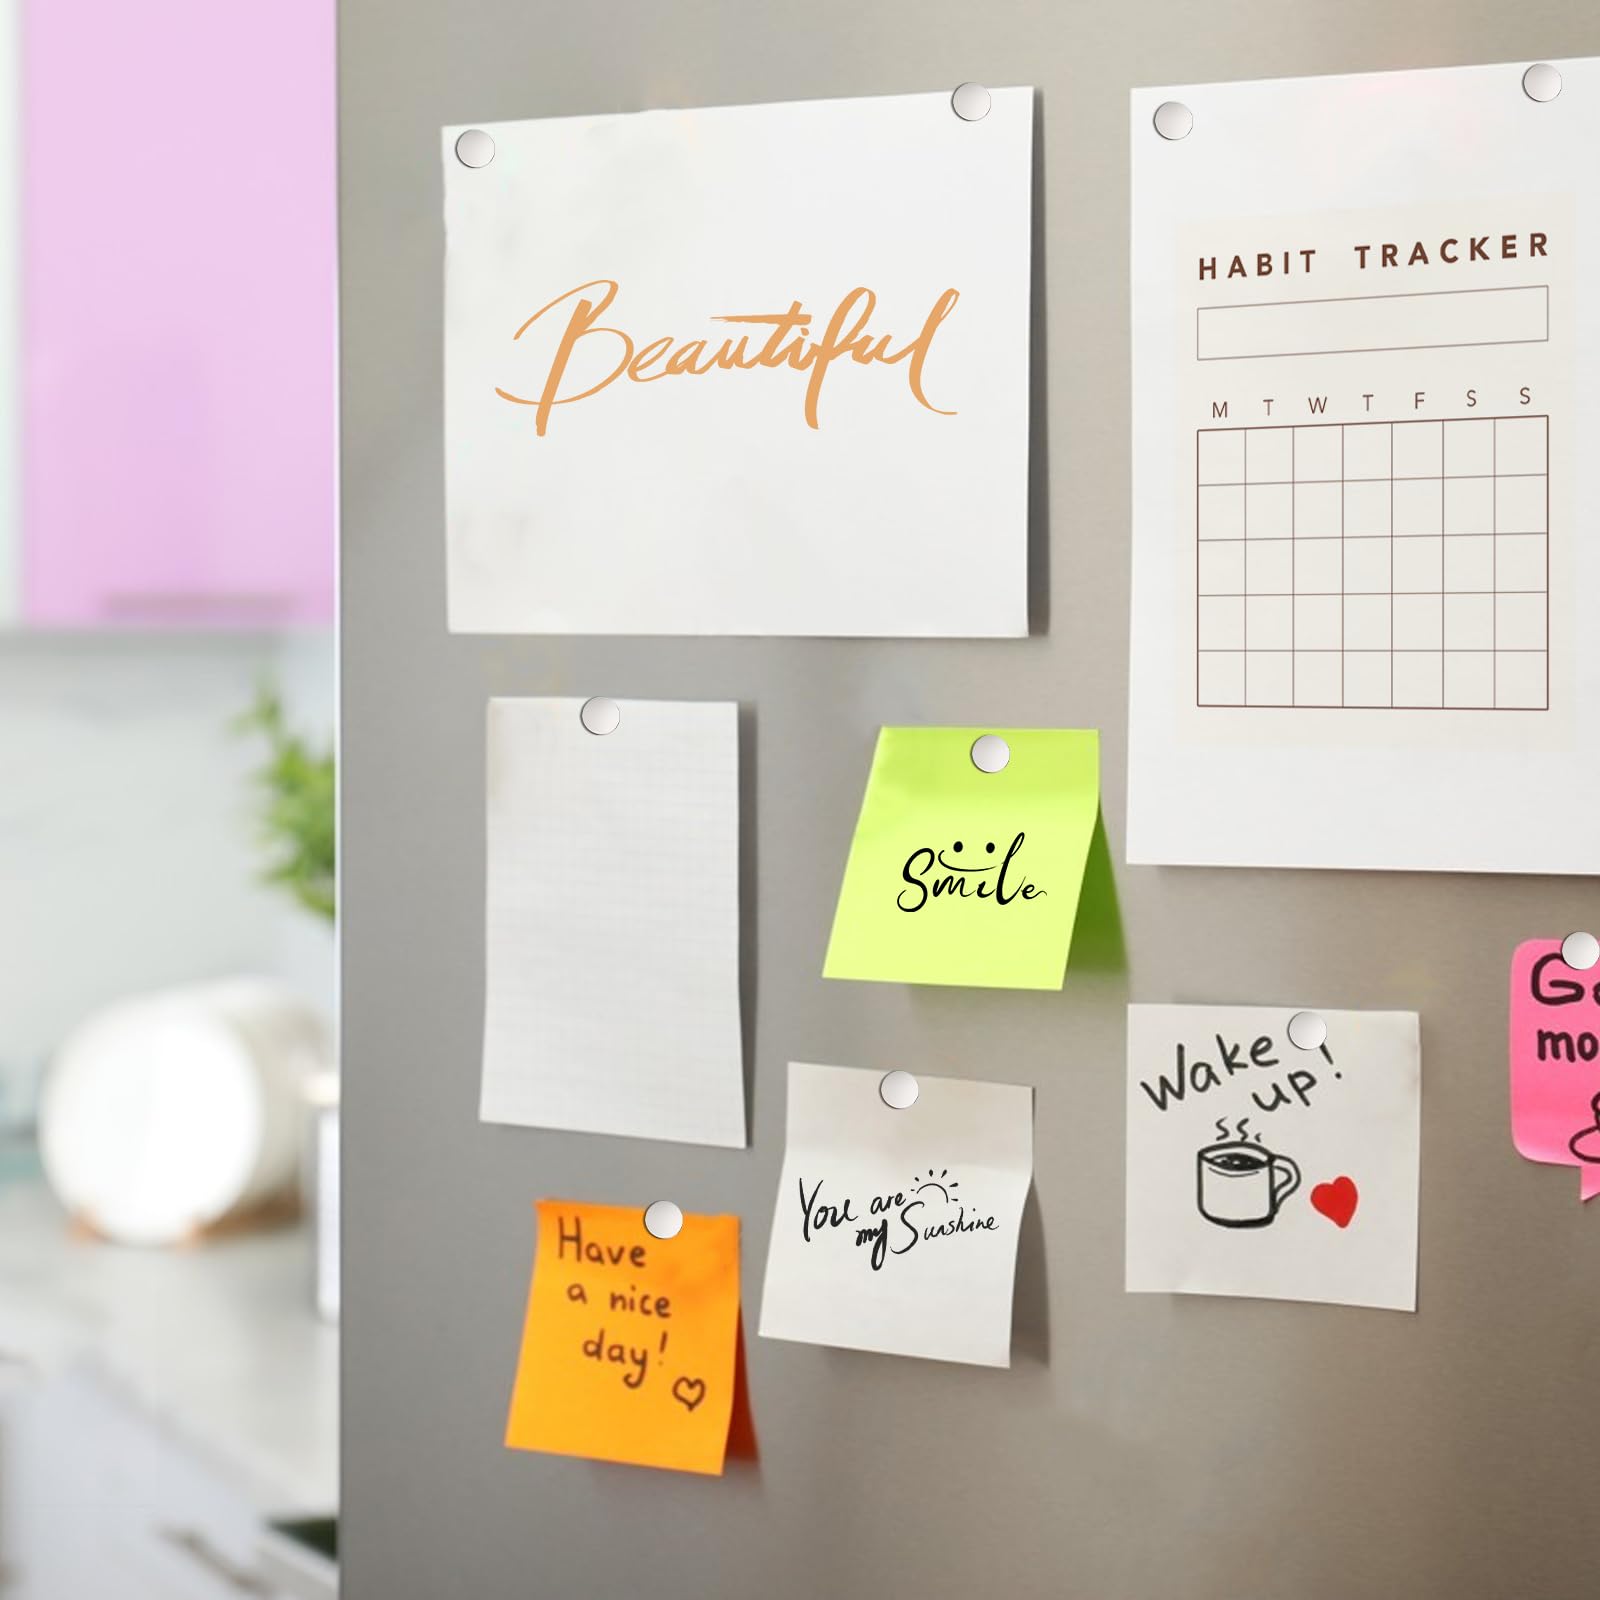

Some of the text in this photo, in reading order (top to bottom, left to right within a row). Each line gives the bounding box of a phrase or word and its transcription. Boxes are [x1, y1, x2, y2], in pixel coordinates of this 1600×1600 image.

[1198, 232, 1549, 281] HABIT TRACKER
[494, 279, 961, 437] Beautiful
[1212, 386, 1532, 419] M T W T F S S
[896, 831, 1048, 913] Smile
[1530, 952, 1600, 1006] G
[1140, 1034, 1280, 1111] Wake
[798, 1177, 907, 1243] You are
[855, 1200, 1000, 1272] my Sunshine
[556, 1216, 648, 1269] Have
[566, 1281, 673, 1320] a nice
[581, 1328, 669, 1391] day!
